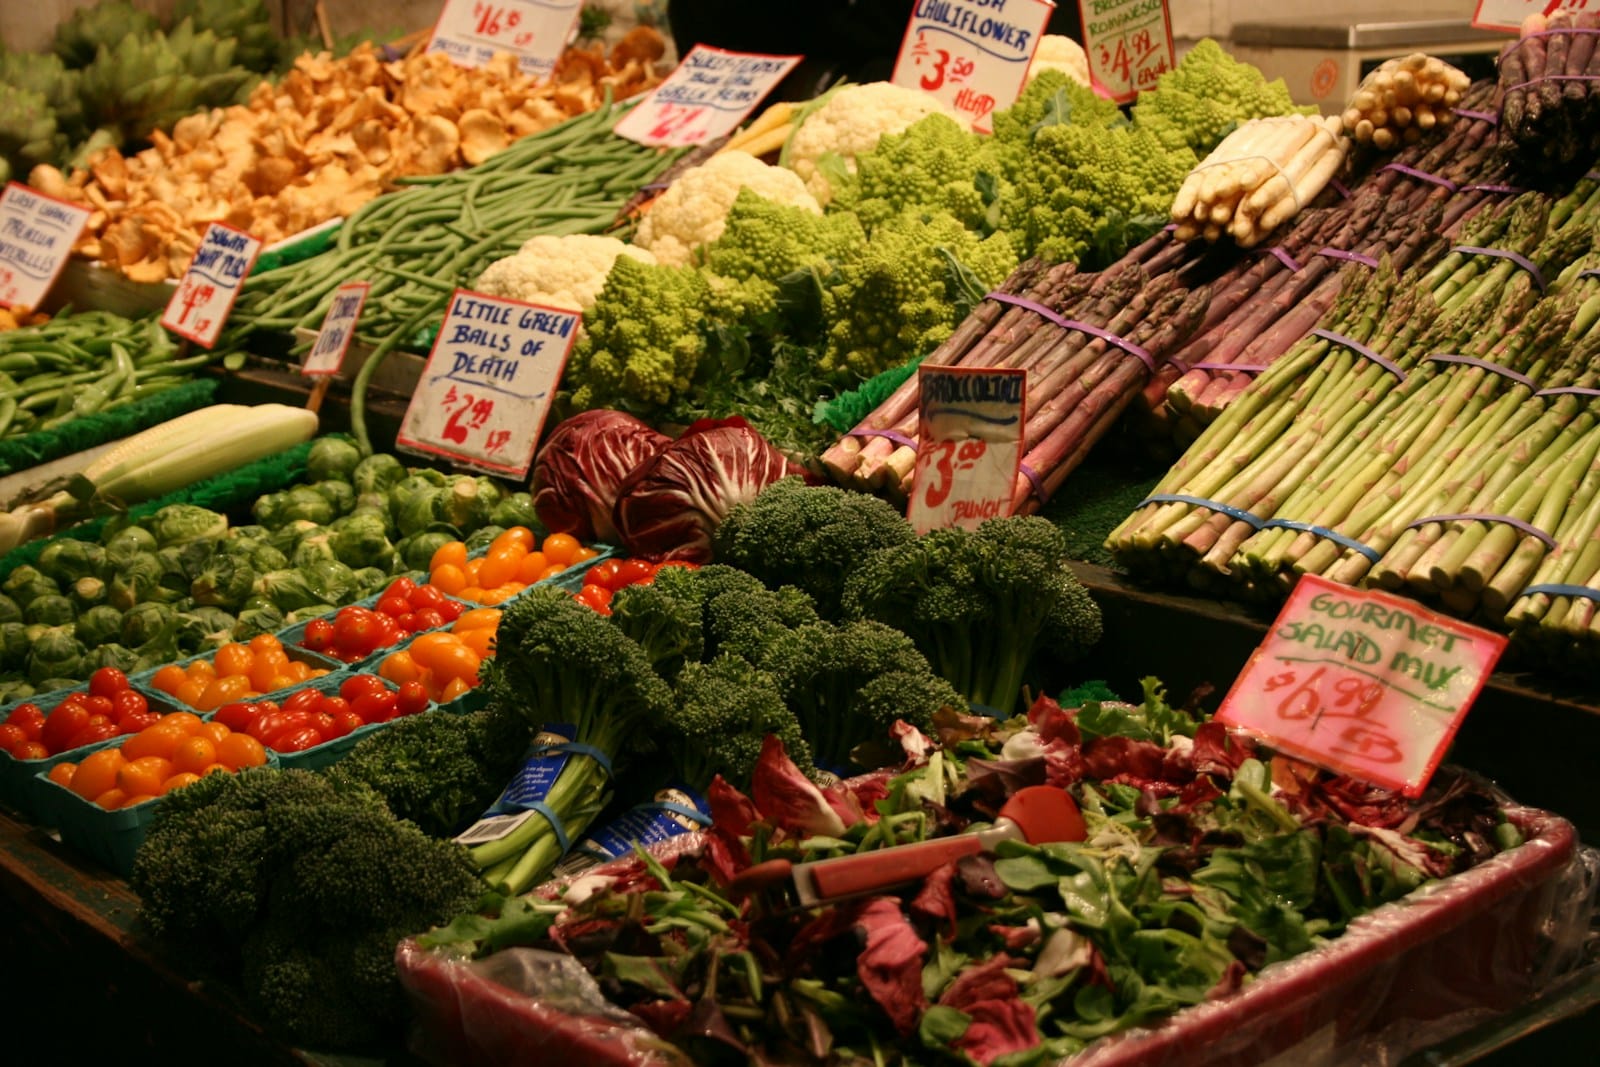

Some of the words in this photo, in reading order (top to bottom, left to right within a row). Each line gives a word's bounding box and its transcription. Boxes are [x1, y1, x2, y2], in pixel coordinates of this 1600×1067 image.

[914, 0, 1031, 51] CAULIFLOWER
[954, 88, 995, 116] HEAD
[452, 297, 513, 325] LITTLE
[518, 308, 575, 339] GREEN
[447, 324, 512, 353] BALLS
[521, 339, 546, 358] OF
[449, 351, 519, 383] DEATH
[951, 497, 1001, 522] BUNCH
[1309, 593, 1474, 653] GOURMET
[1277, 621, 1382, 666] SALAD
